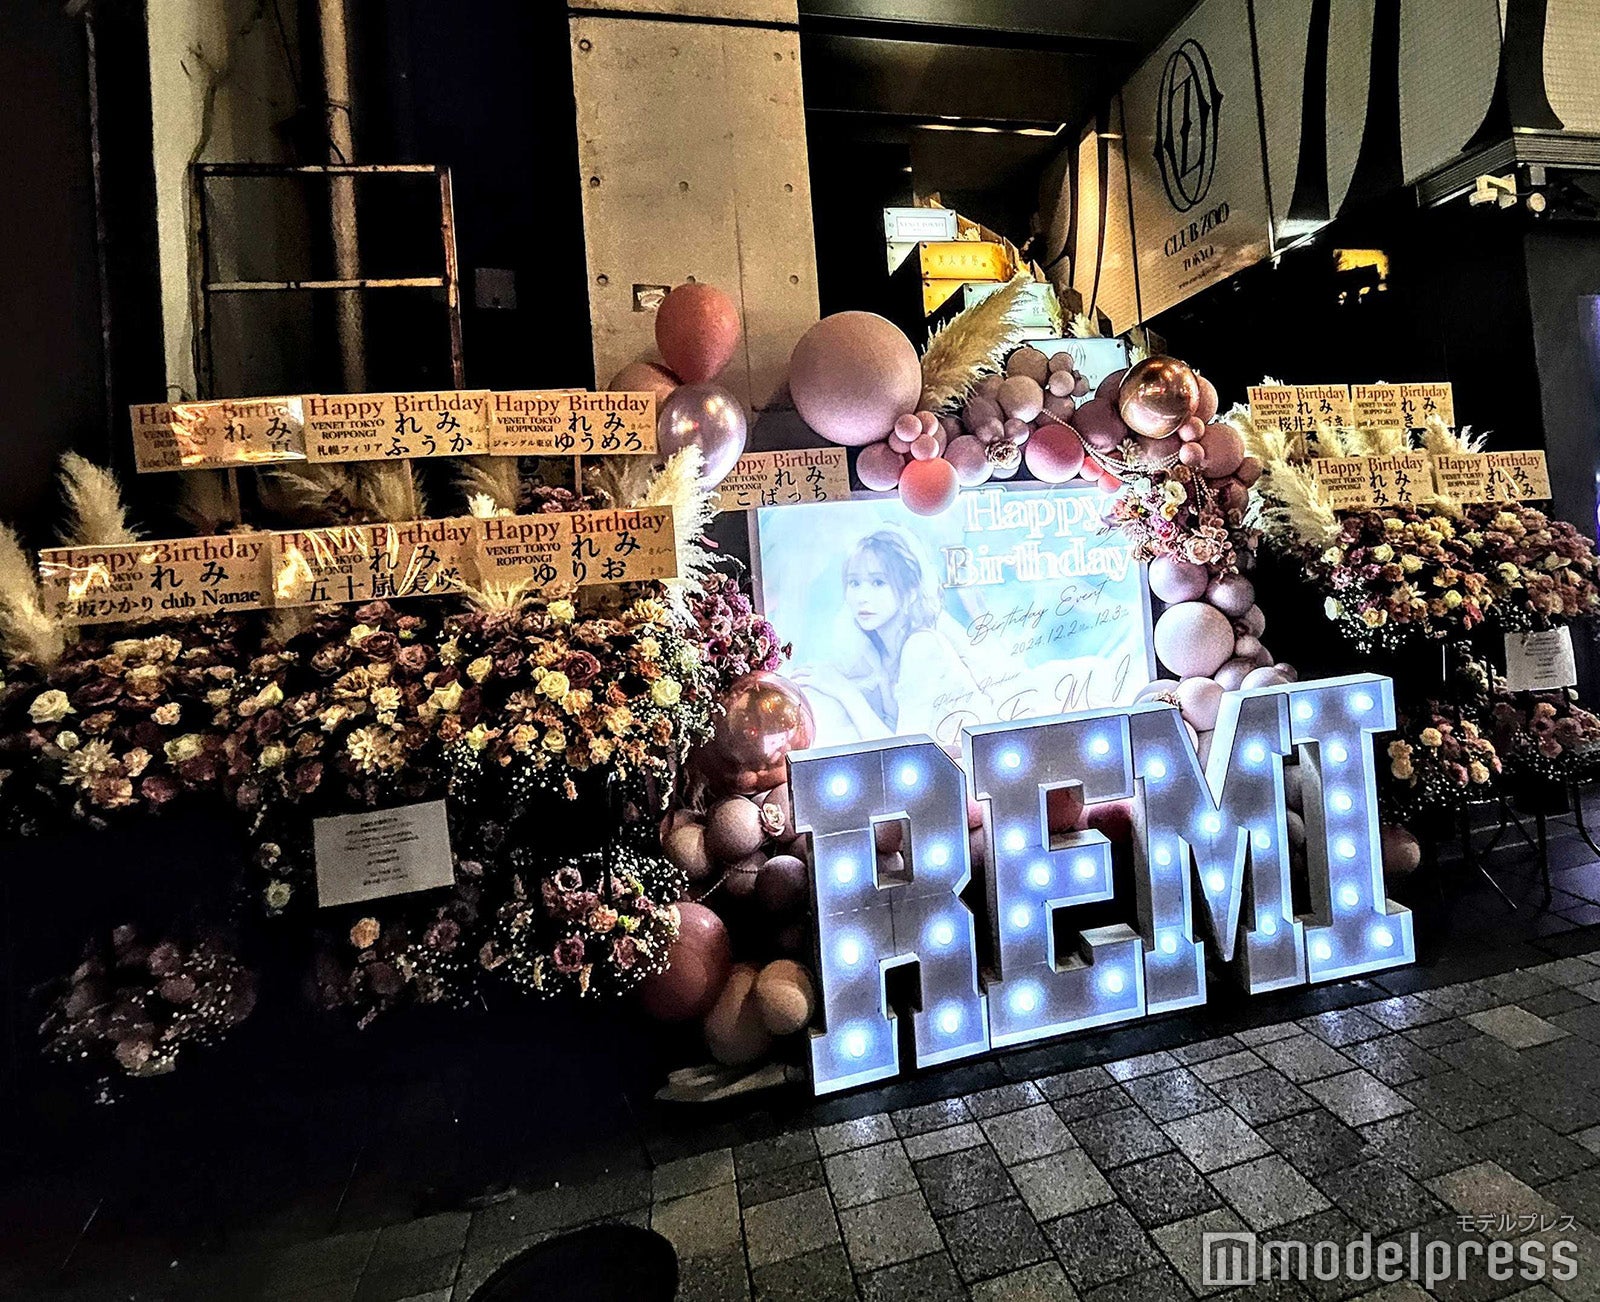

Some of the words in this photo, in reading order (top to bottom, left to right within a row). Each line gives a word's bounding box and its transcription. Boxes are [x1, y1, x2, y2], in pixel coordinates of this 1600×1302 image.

[1252, 388, 1292, 403] Happy
[1296, 386, 1346, 402] Birthday
[1356, 386, 1395, 402] Happy
[1400, 385, 1449, 399] Birthday
[309, 397, 385, 420] Happy
[394, 393, 484, 415] Birthday
[495, 394, 561, 416] Happy
[569, 393, 650, 416] Birthday
[1297, 399, 1333, 415] れみ
[1401, 397, 1437, 413] れみ
[224, 417, 292, 443] れみ
[311, 421, 346, 430] VENET
[350, 419, 385, 429] TOKYO
[395, 411, 460, 436] れみ
[497, 416, 528, 425] VENET
[529, 416, 562, 425] TOKYO
[506, 425, 554, 433] ROPPONGI
[568, 412, 626, 434] れみ
[322, 430, 377, 440] ROPPONGI
[385, 432, 473, 457] ふうか
[554, 432, 643, 453] ゆうめろ
[773, 450, 842, 469] Birthday
[1317, 460, 1363, 477] Happy
[1367, 456, 1424, 473] Birthday
[1438, 456, 1481, 473] Happy
[1486, 453, 1541, 469] Birthday
[740, 474, 768, 483] TOKYO
[775, 466, 826, 488] れみ
[1370, 470, 1411, 489] れみ
[1488, 466, 1529, 485] れみ
[721, 483, 763, 492] ROPPONGI
[1373, 488, 1413, 506] みな
[962, 486, 1108, 539] Happy
[371, 522, 472, 547] Brthday
[484, 519, 561, 543] Happy
[570, 511, 666, 534] Birthday
[153, 538, 263, 563] Birthday
[486, 545, 521, 556] VENET
[523, 542, 562, 554] TOKYO
[571, 531, 641, 560] れみ
[369, 544, 440, 573] れみ
[496, 555, 553, 567] ROPPONGI
[941, 537, 1134, 589] Birthday
[150, 561, 229, 591] れみ
[533, 557, 627, 587] ゆりお
[161, 591, 196, 610] club
[202, 588, 261, 607] Nanae
[967, 601, 1049, 646] Birthday
[786, 673, 1415, 1096] REMI
